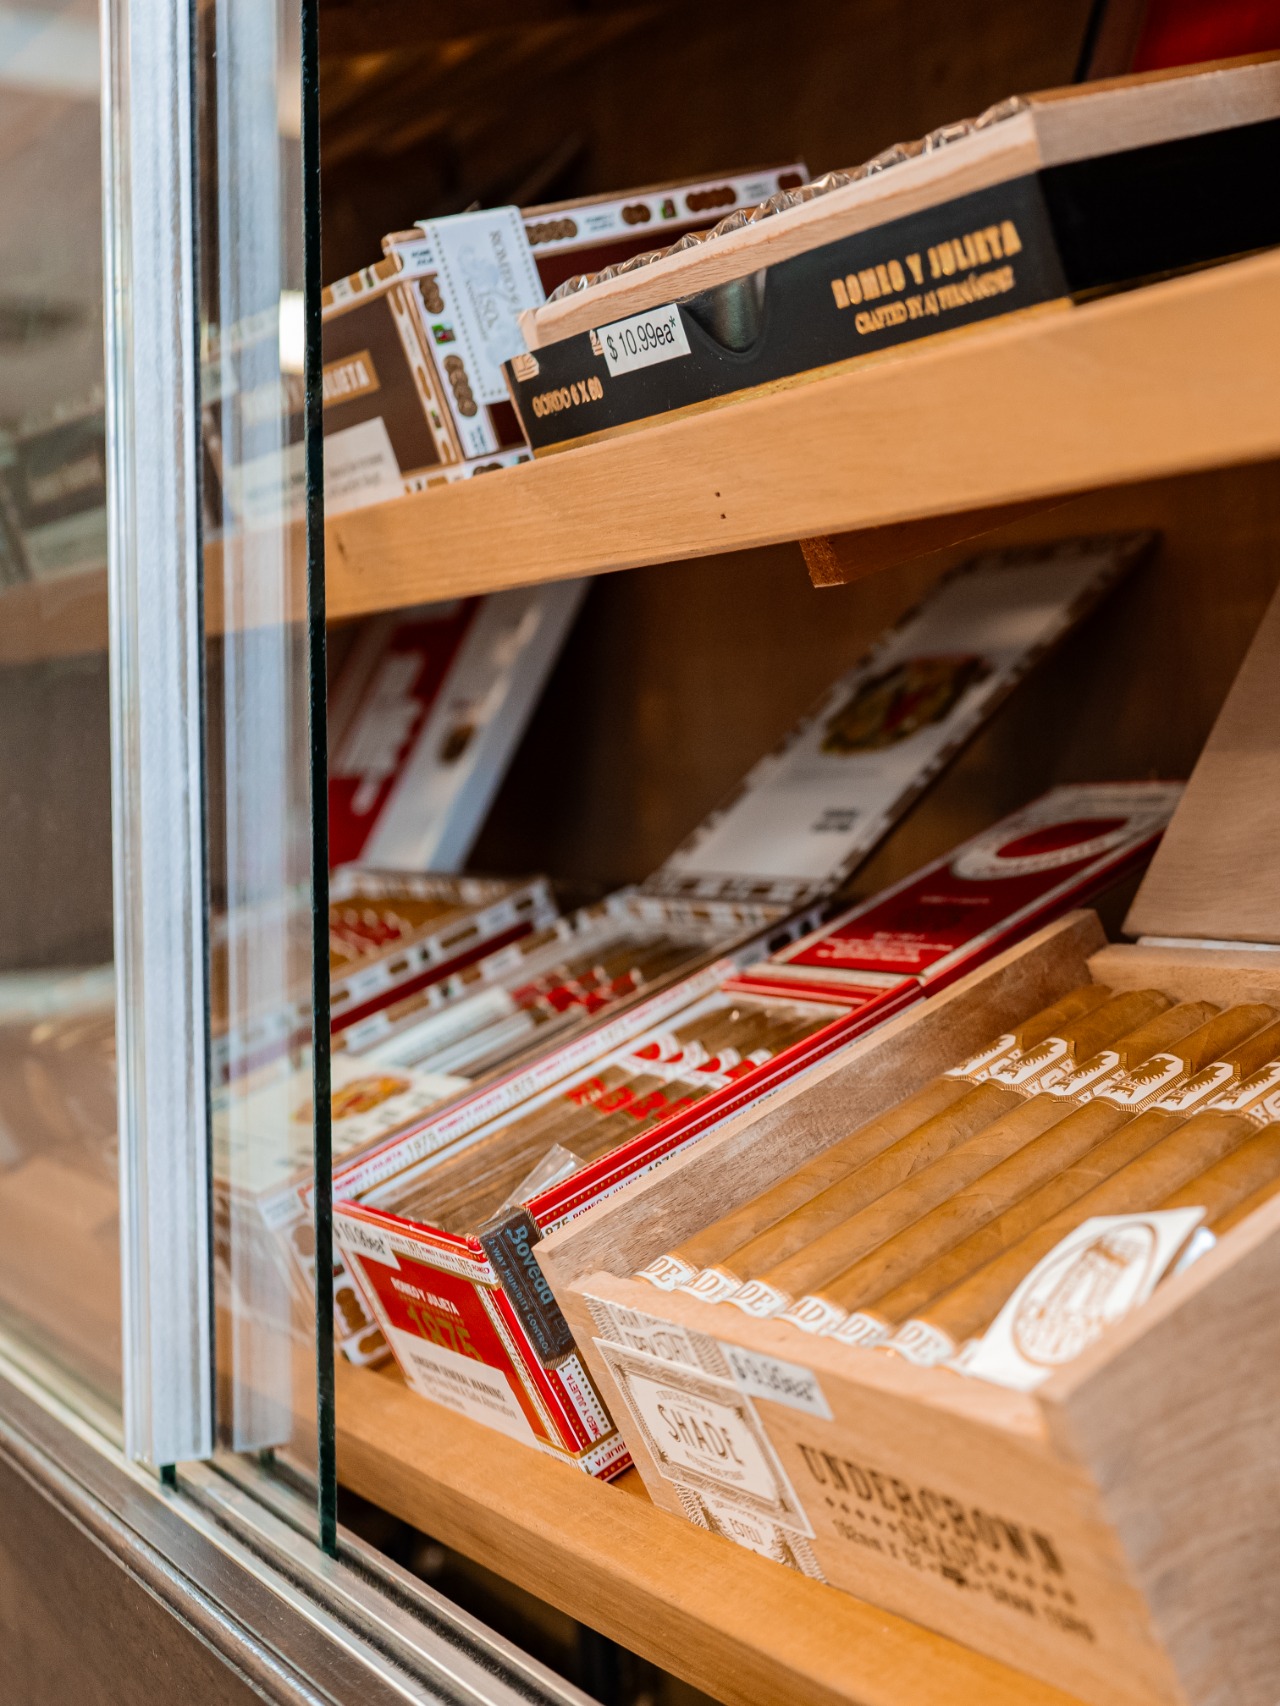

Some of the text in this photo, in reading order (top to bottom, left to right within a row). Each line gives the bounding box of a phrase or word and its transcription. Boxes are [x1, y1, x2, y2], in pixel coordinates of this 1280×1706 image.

[831, 219, 1023, 310] ROMEO Y JULIETA
[606, 333, 619, 364] $
[503, 1269, 530, 1311] HUMIDITY
[526, 1313, 551, 1354] CONTROL
[656, 1403, 746, 1467] SHADE
[796, 1441, 1066, 1576] UNDERCROWN
